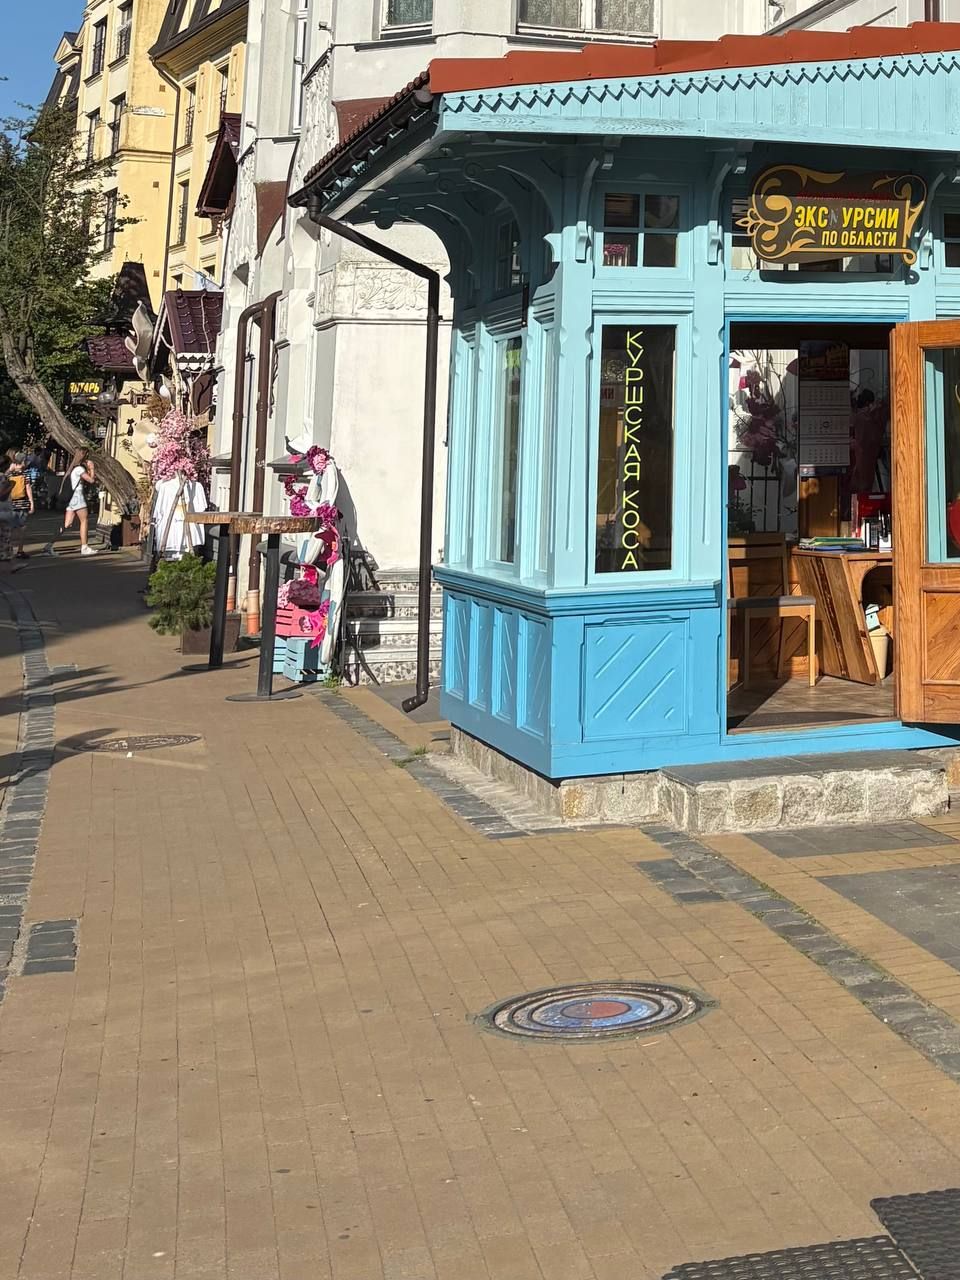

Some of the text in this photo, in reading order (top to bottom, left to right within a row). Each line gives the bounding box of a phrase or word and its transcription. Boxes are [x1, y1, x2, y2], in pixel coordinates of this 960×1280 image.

[794, 205, 900, 229] ЭКСУРСИИ
[821, 231, 897, 247] ПО ОБЛАСТИ
[621, 330, 644, 570] КУРШСКАЯ КОСА
